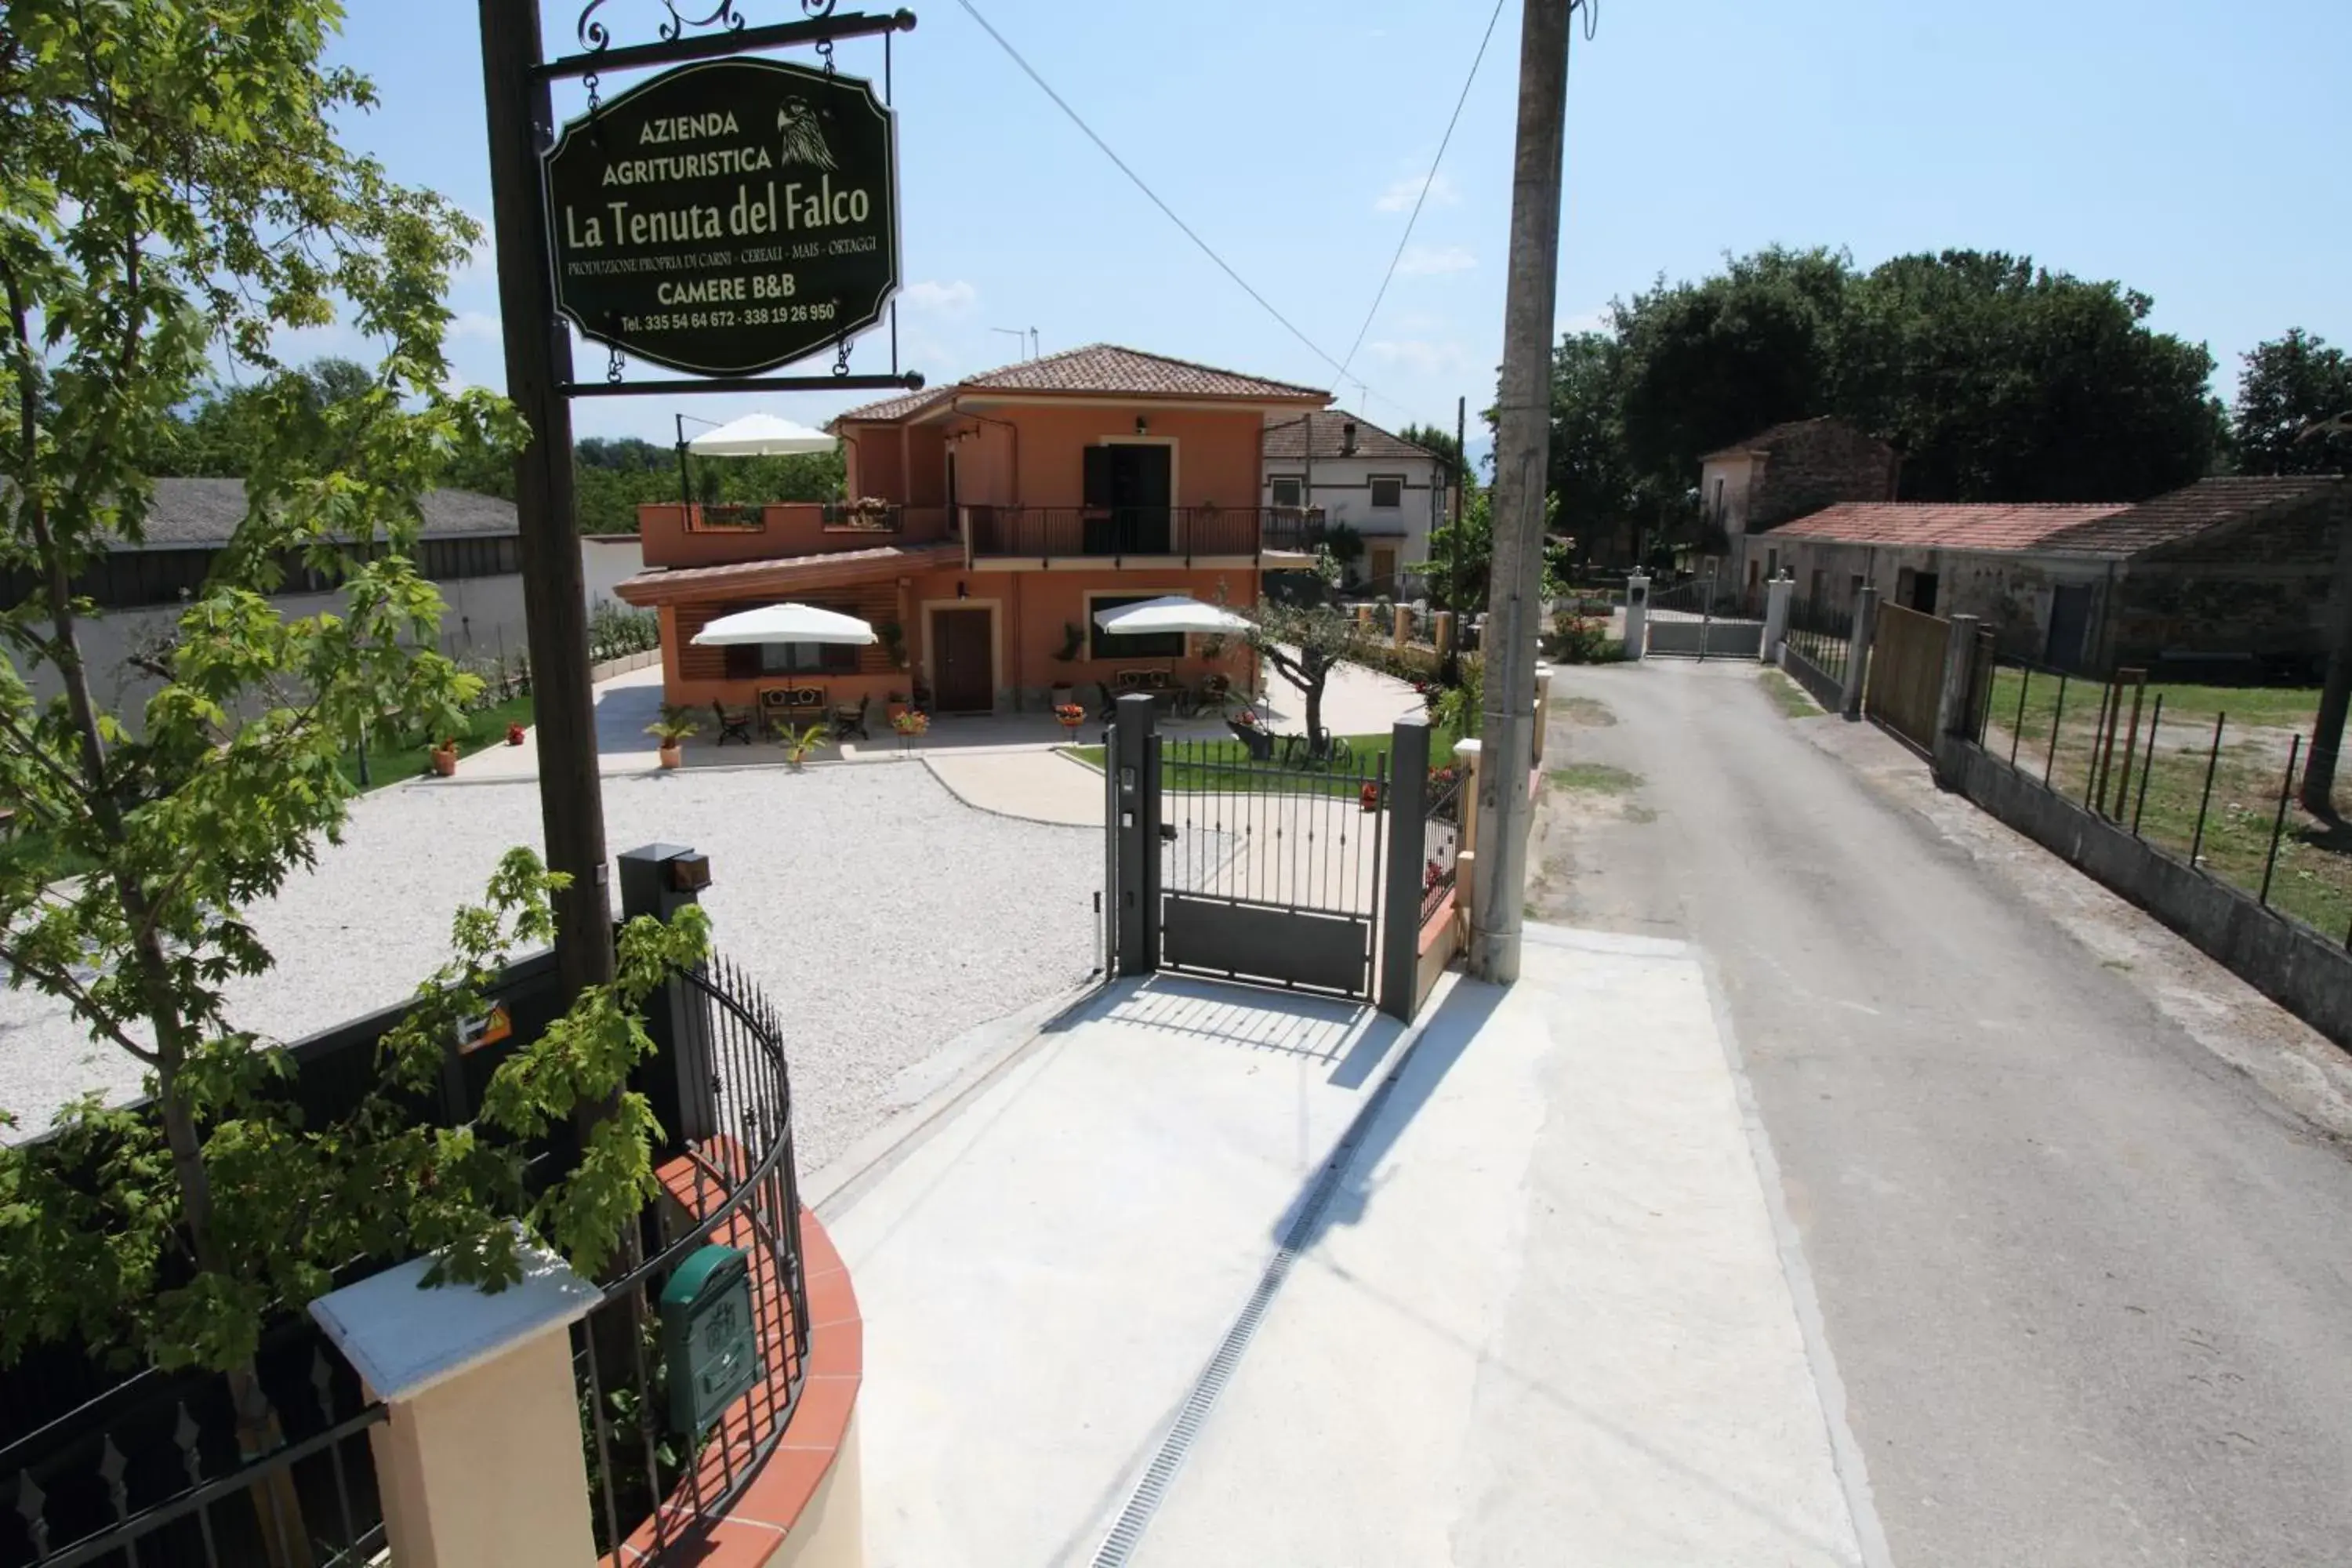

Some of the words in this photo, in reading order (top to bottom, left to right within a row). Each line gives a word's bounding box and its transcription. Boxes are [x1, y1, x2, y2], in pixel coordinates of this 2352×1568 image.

[639, 110, 739, 144] AZIENDA
[602, 146, 771, 187] AGRITURISTICA
[566, 205, 604, 249] La
[607, 201, 723, 245] Tenuta
[730, 180, 777, 235] del
[786, 173, 869, 230] Falco
[699, 250, 731, 267] CARNI
[741, 245, 782, 264] CEREALI
[792, 241, 819, 259] MAIS
[829, 236, 877, 256] ORTAGGI
[657, 277, 746, 305] CAMERE
[753, 274, 796, 298] B&B
[621, 317, 643, 332] Tel.
[645, 314, 670, 331] 335
[672, 314, 688, 329] 54
[691, 312, 707, 328] 64
[710, 310, 735, 327] 672
[744, 308, 768, 325] 338
[771, 307, 788, 323] 19
[790, 305, 808, 321] 26
[810, 303, 835, 321] 950
